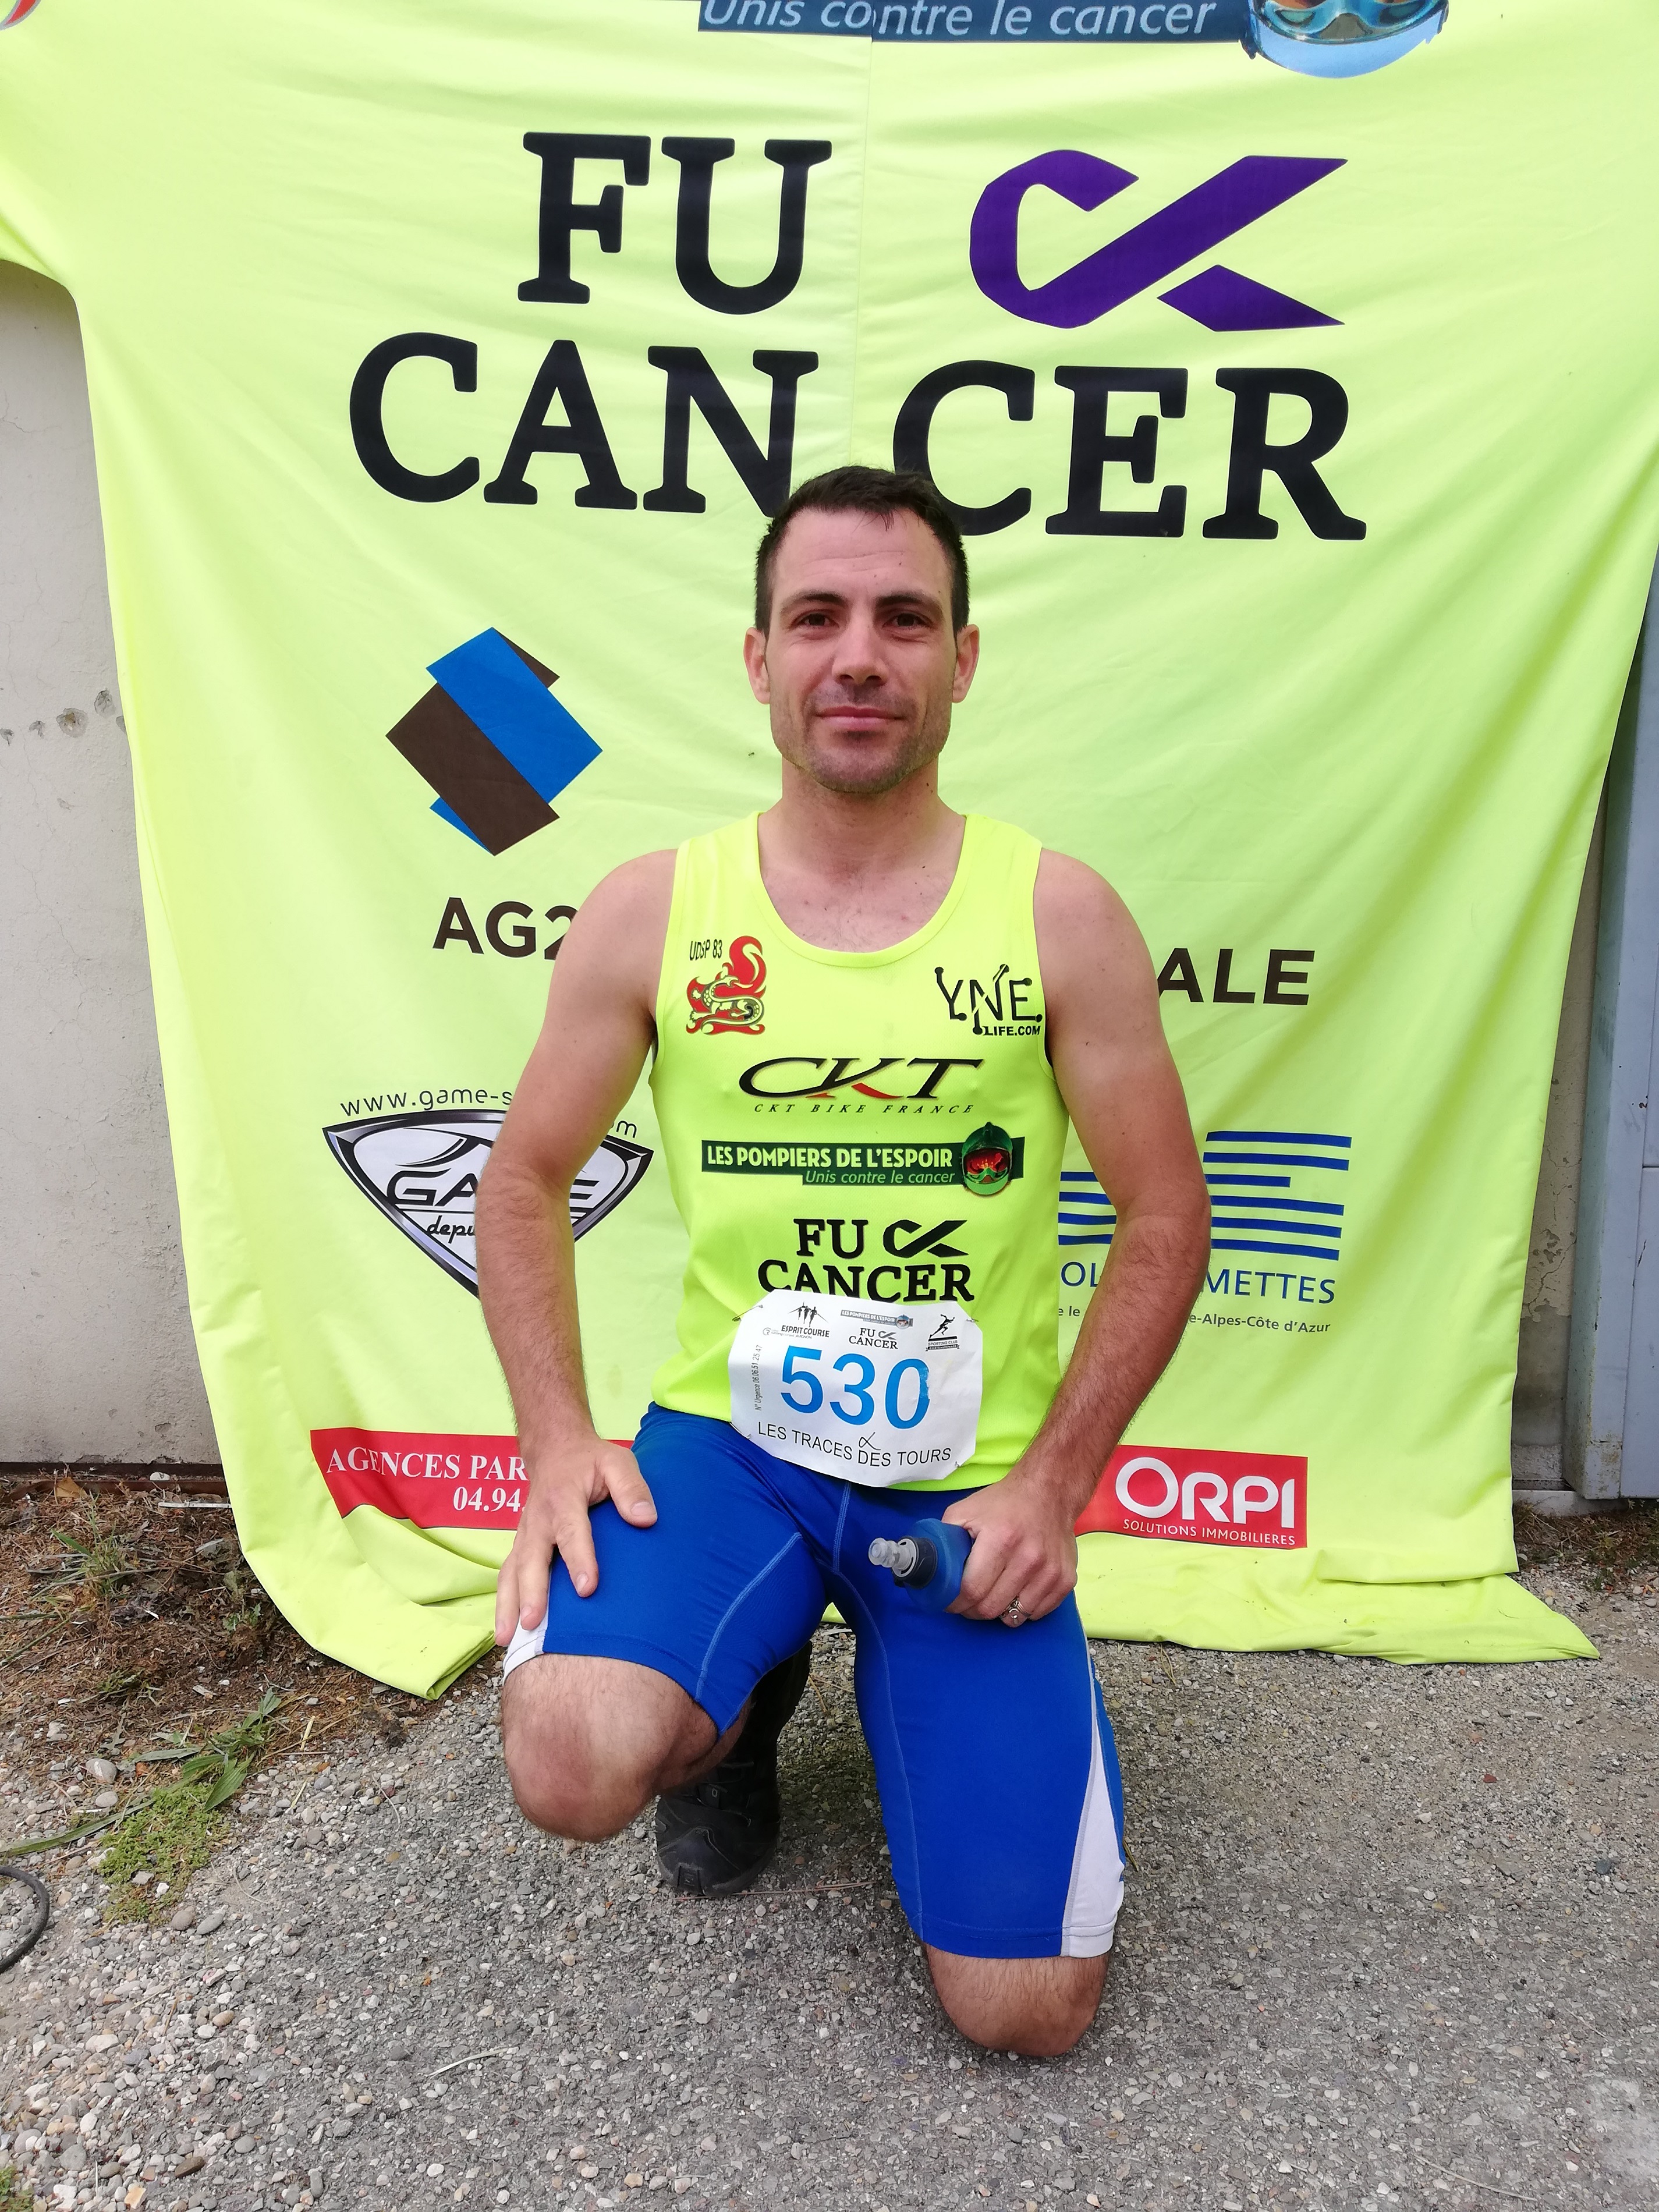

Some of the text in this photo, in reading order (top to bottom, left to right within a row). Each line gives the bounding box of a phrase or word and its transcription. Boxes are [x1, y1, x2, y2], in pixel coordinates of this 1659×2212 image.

[703, 0, 1218, 35] Unis contre le cancer
[517, 132, 833, 316] FU
[689, 939, 722, 961] UDSP 83
[1157, 948, 1316, 1005] ALE
[983, 1025, 1041, 1036] LIFE.COM
[739, 1057, 984, 1099] CKT
[754, 1104, 974, 1114] CKT BIKE FRANCE
[707, 1146, 733, 1166] LES
[736, 1146, 832, 1168] POMPIERS
[836, 1148, 862, 1168] DE
[806, 1169, 955, 1184] Unis contre le cancer
[793, 1218, 869, 1259] FU
[758, 1259, 974, 1303] CANCER
[849, 1311, 870, 1319] POMPIERS
[781, 1325, 803, 1334] ESPRIT
[804, 1327, 830, 1338] COURSE
[849, 1335, 898, 1349] CANCER
[859, 1327, 875, 1338] FU
[780, 1345, 931, 1430] 530
[758, 1422, 951, 1467] LES TRACES DES TOURS
[327, 1447, 460, 1479] AGENCES
[1115, 1456, 1295, 1529] ORPI
[1123, 1519, 1295, 1545] SOLUTIONS IMMOBILIERES
